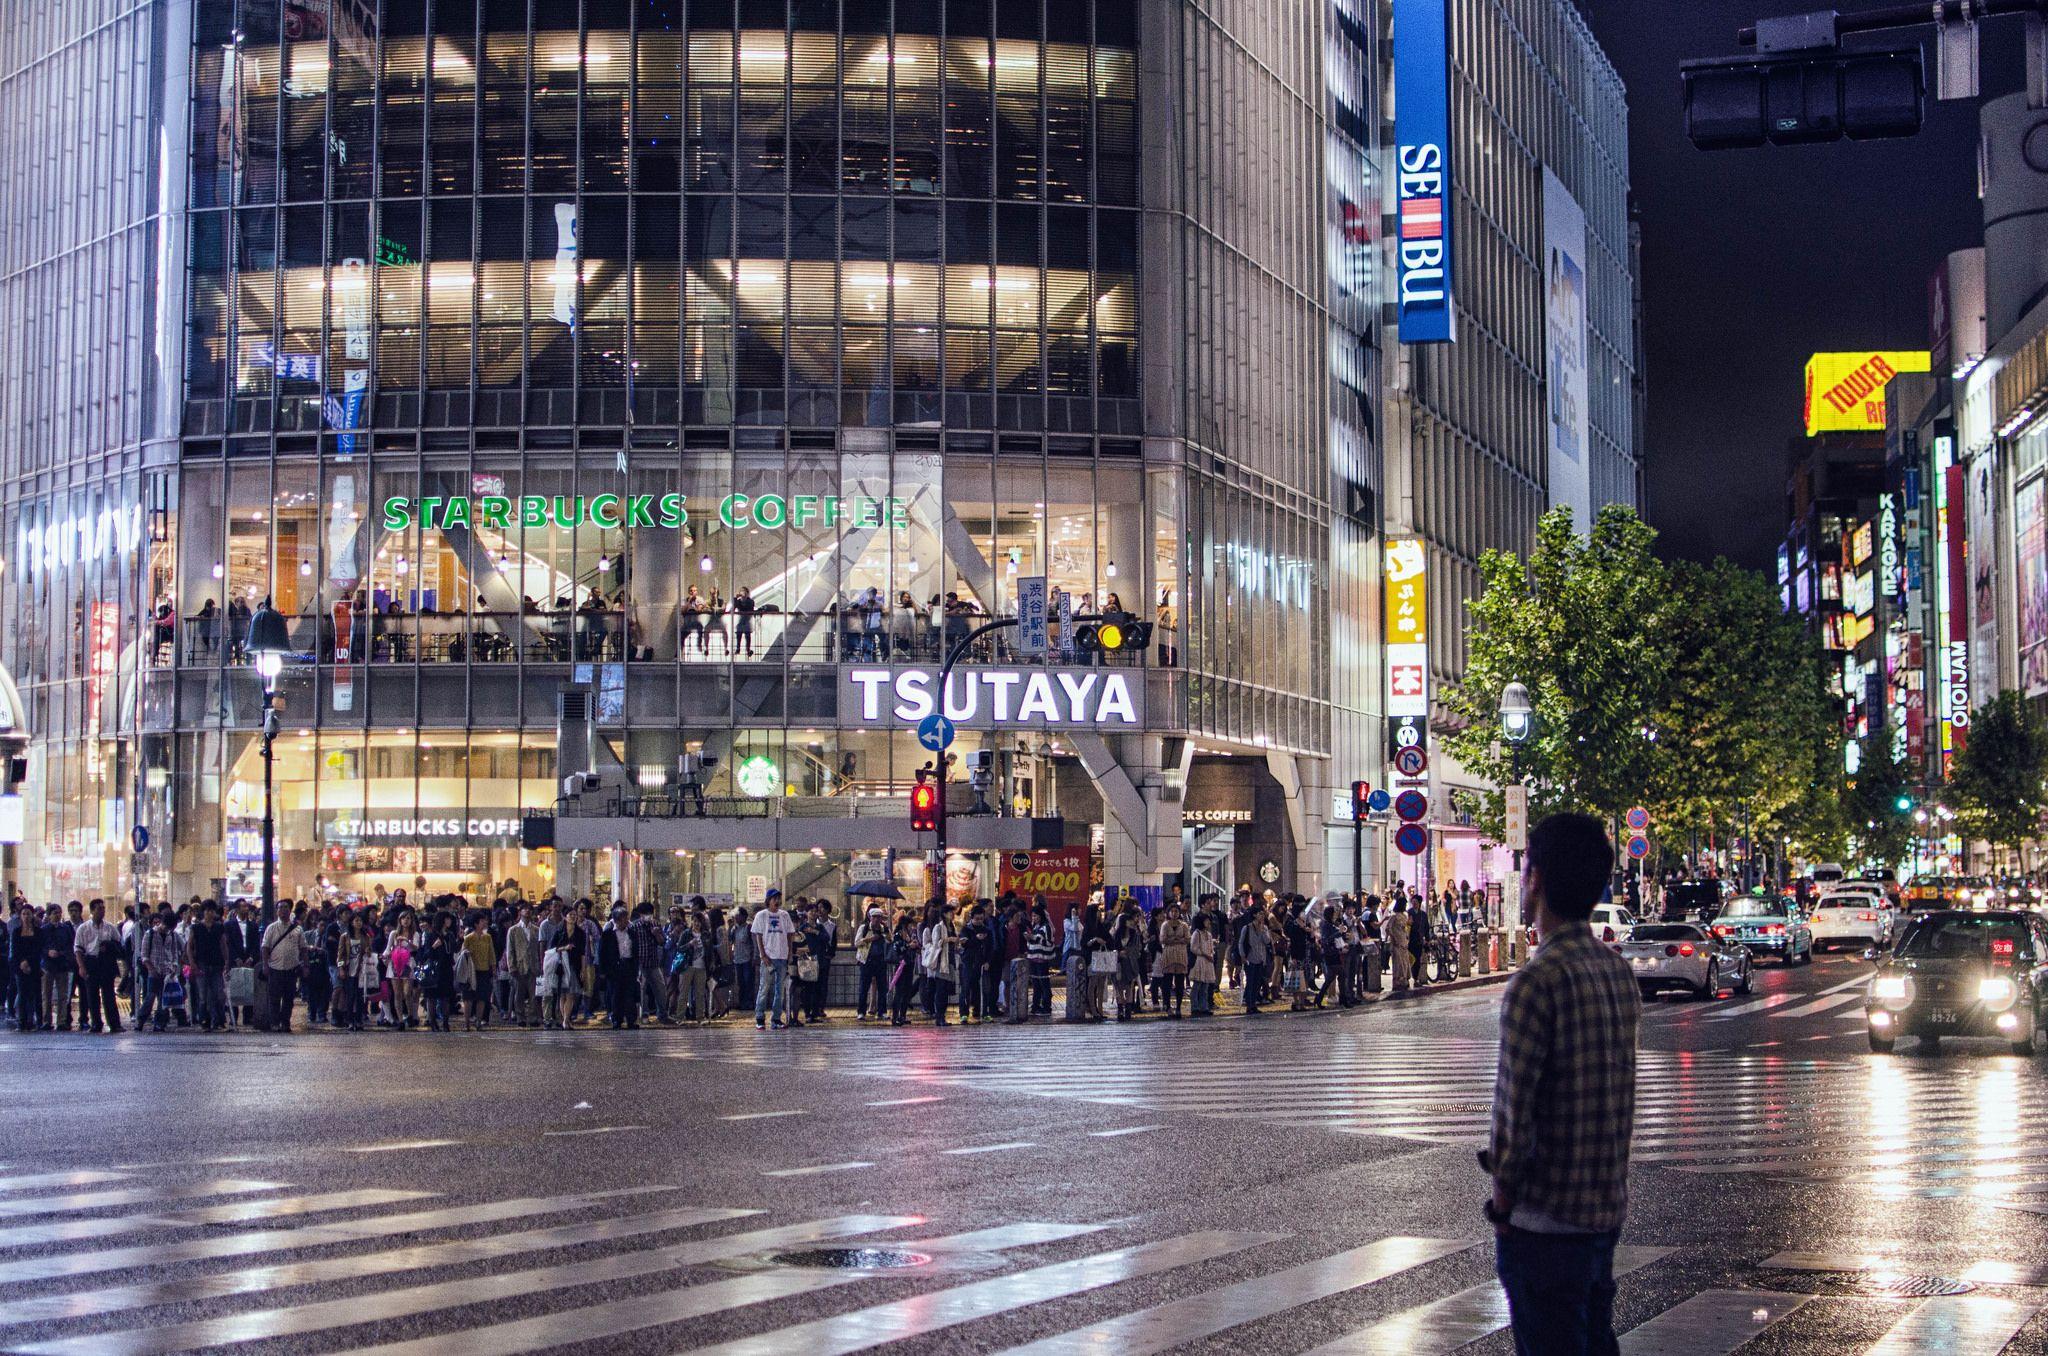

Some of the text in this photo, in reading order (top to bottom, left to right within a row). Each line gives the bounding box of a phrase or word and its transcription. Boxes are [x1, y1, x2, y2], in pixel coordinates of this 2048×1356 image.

[1822, 354, 1898, 414] TOWER
[384, 494, 909, 531] STARBUCKS COFFEE
[1879, 492, 1898, 596] KARAOKE
[1029, 582, 1044, 648] 渋谷駅前
[851, 670, 1137, 723] TSUTAYA
[337, 818, 460, 836] STARBUCKS
[1204, 810, 1252, 821] COFFEE
[1012, 857, 1029, 866] DVD
[1009, 870, 1080, 893] ¥1,000
[1993, 943, 2013, 953] 空車
